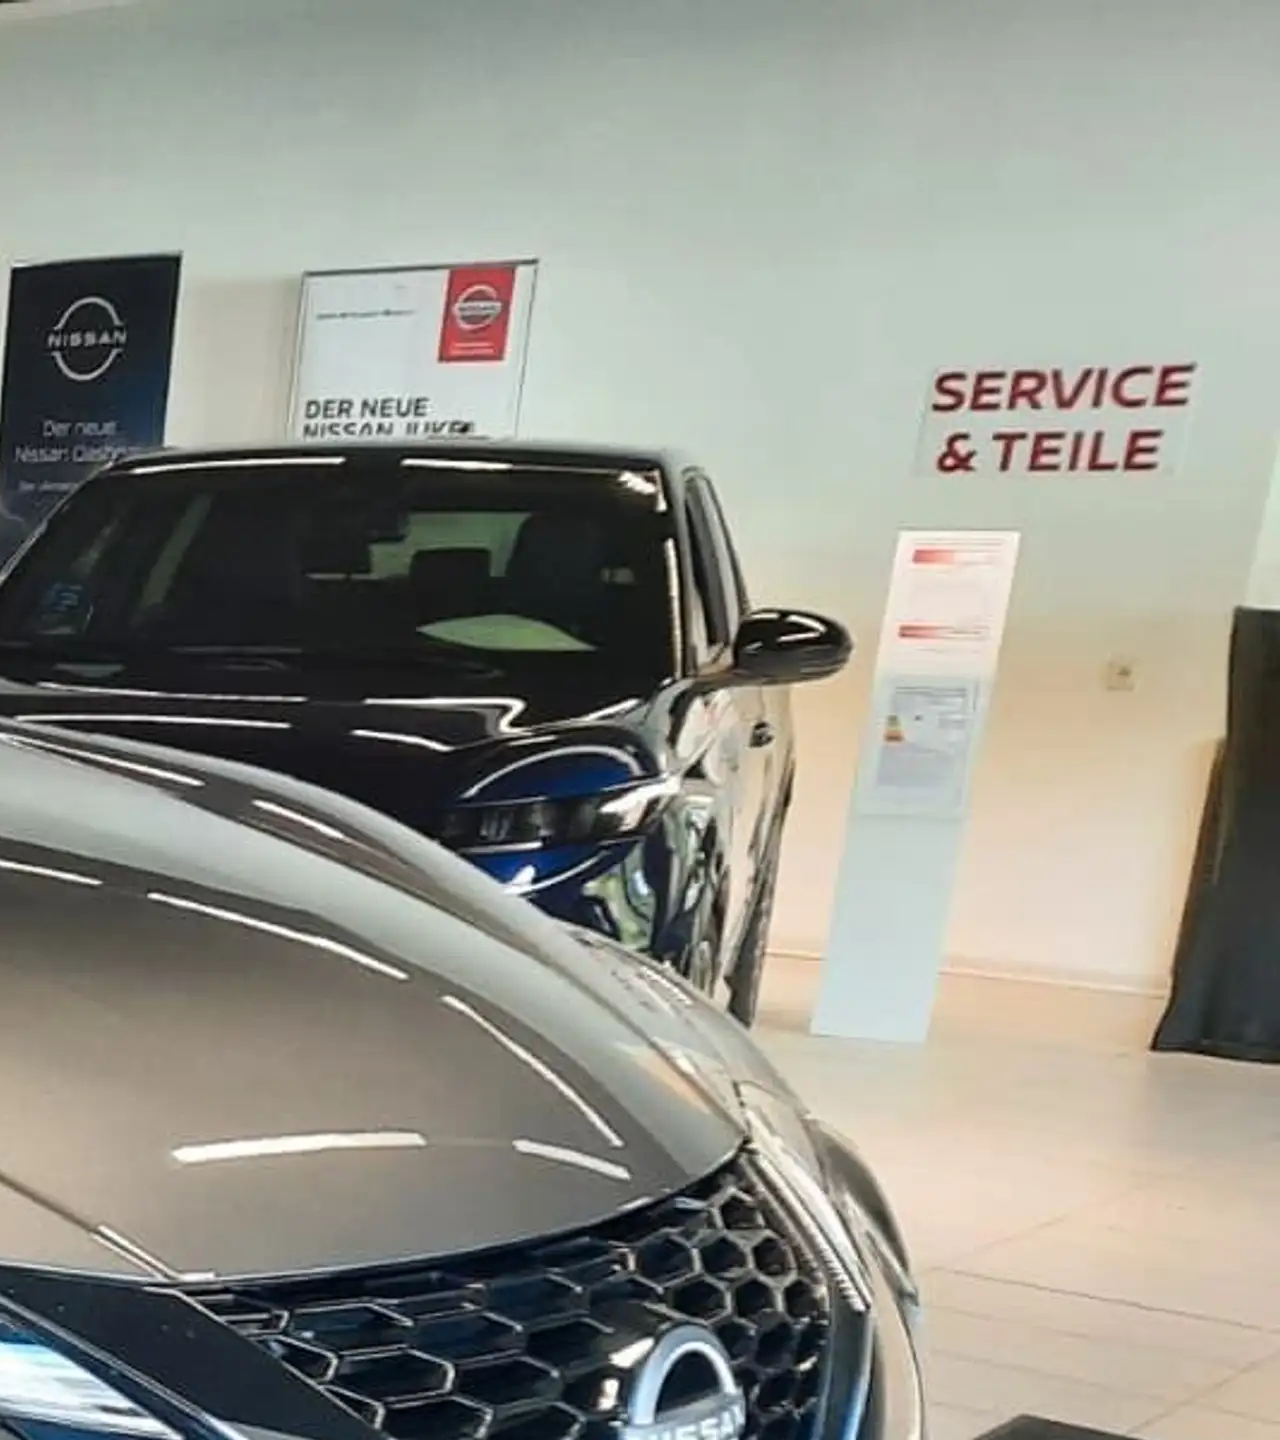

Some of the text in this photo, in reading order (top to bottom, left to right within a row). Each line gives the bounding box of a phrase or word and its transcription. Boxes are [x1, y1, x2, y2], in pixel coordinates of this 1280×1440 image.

[48, 329, 127, 348] NISSAN
[931, 362, 1196, 412] SERVICE
[305, 397, 430, 419] DER NEUE
[43, 420, 118, 437] Der neue
[303, 420, 394, 438] NISSAN
[15, 446, 69, 463] Nissan
[936, 429, 1164, 473] & TEILE
